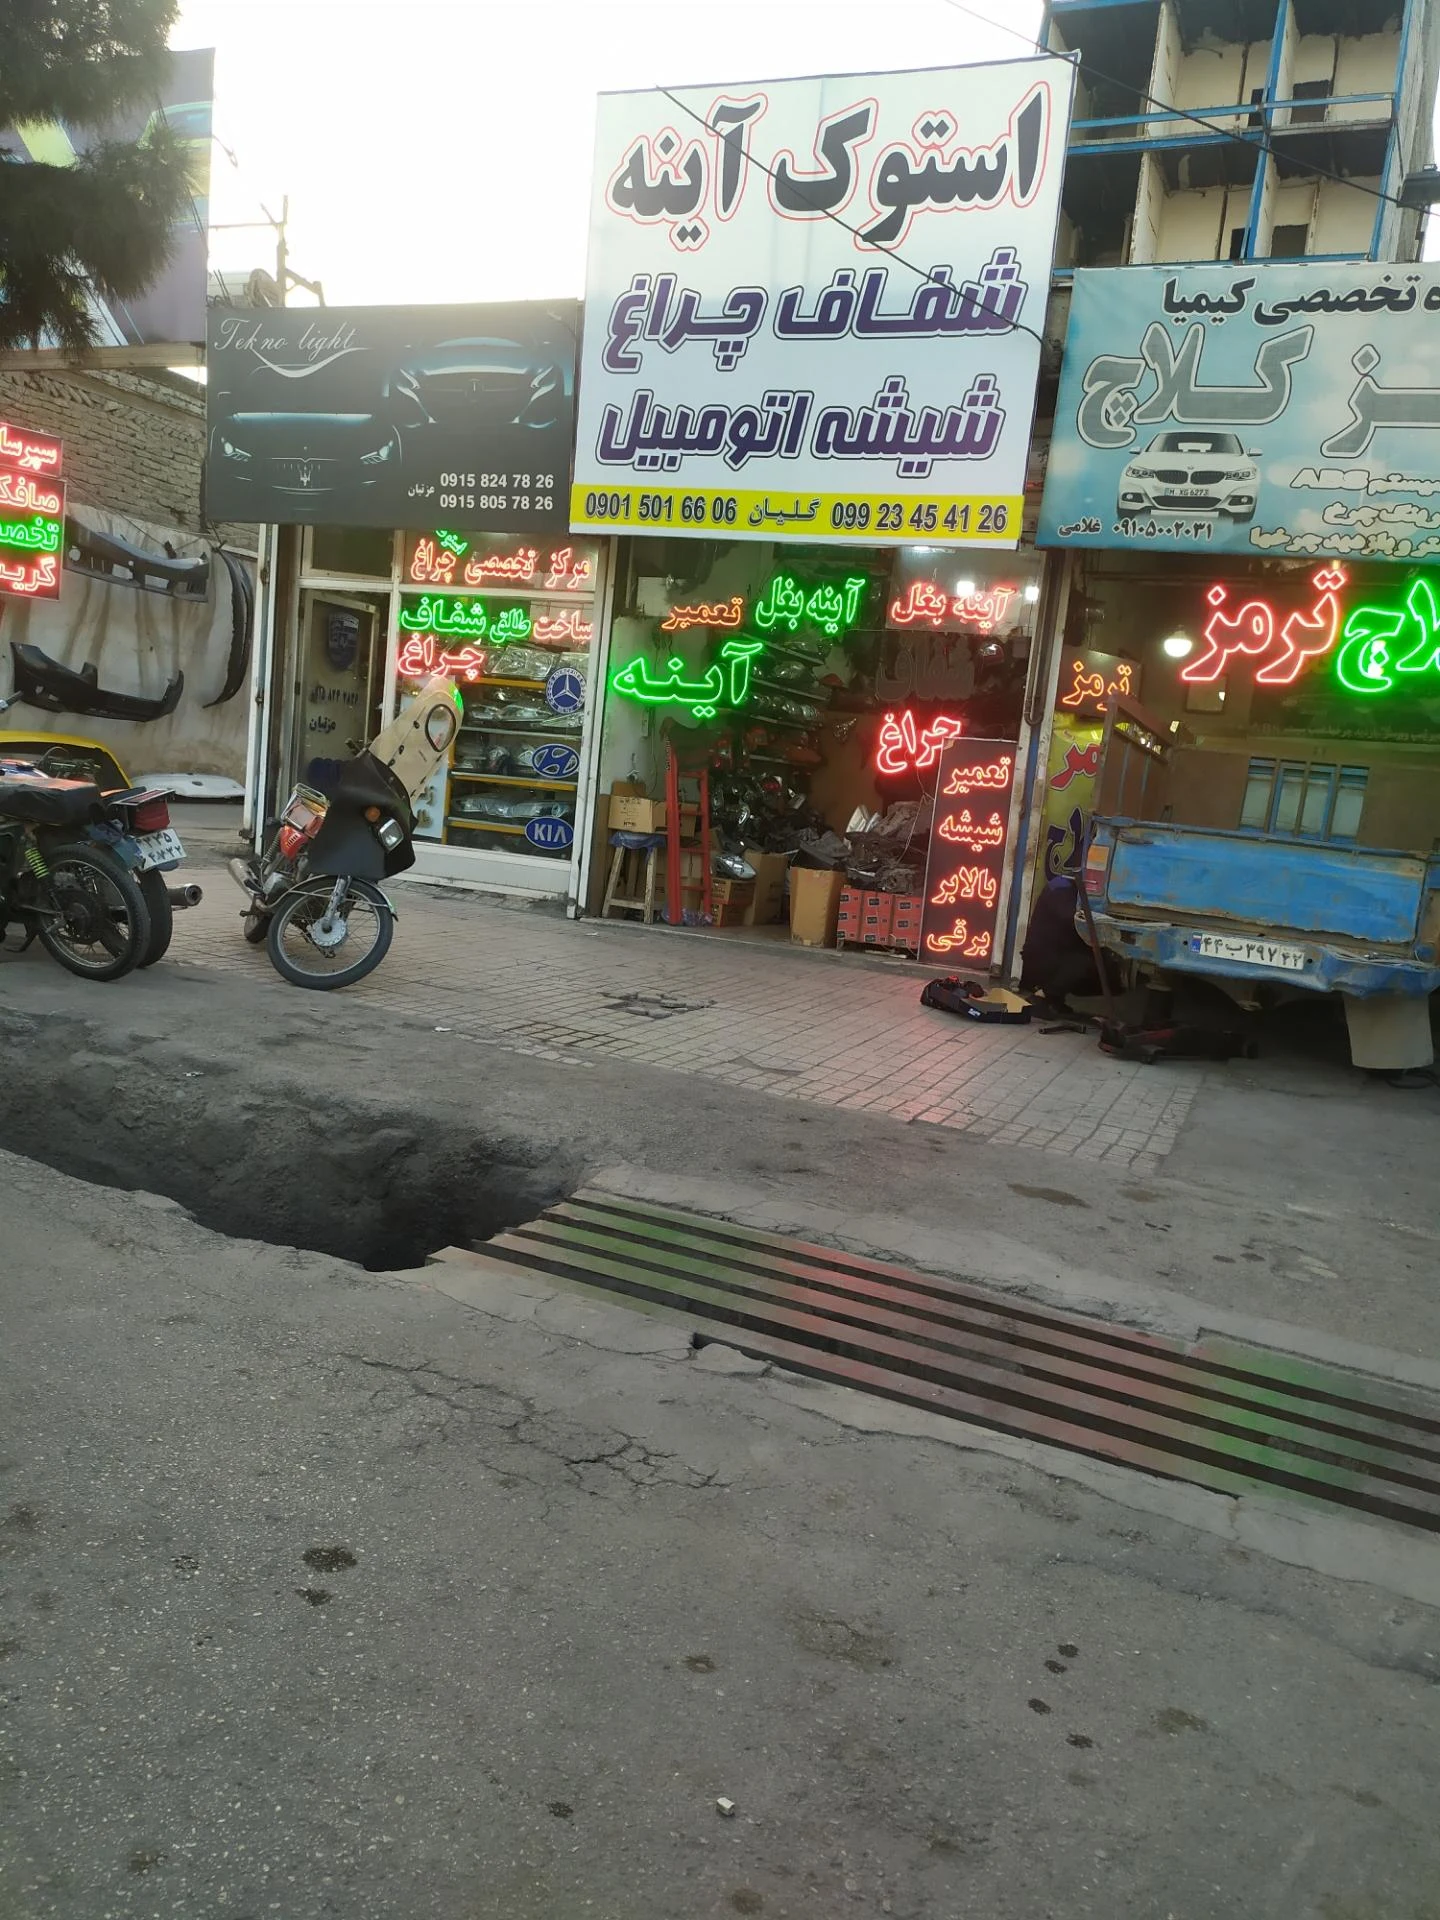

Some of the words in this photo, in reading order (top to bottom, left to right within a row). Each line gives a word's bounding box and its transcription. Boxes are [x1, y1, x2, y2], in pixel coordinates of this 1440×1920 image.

[608, 97, 765, 246] آینه
[769, 87, 1046, 246] استوک
[775, 249, 1026, 336] شفاف
[1164, 276, 1257, 325] کیمیا
[1253, 275, 1421, 326] تخصصی
[214, 318, 288, 351] Tekno
[298, 321, 358, 361] light
[603, 274, 767, 372] چراغ
[1077, 321, 1314, 449] کلاچ
[597, 390, 813, 470] اتومبیل
[811, 376, 1004, 477] شیشه
[439, 494, 475, 509] 0915
[479, 495, 507, 510] 805
[511, 495, 530, 510] 78
[534, 496, 554, 510] 26
[440, 472, 476, 488] 0915
[480, 473, 507, 489] 824
[512, 474, 531, 489] 78
[535, 474, 554, 489] 26
[585, 492, 631, 520] 0901
[637, 494, 673, 521] 501
[680, 494, 705, 522] 66
[711, 496, 737, 523] 06
[747, 496, 820, 526] گلیان
[831, 501, 871, 530] 099
[874, 503, 904, 530] 23
[909, 504, 937, 531] 45
[942, 504, 970, 532] 41
[977, 504, 1008, 533] 26
[410, 538, 457, 584] چراغ
[465, 547, 537, 585] تخصصی
[545, 547, 591, 589] مرکز
[400, 597, 487, 635] شفاف
[533, 610, 594, 640] ساخت
[661, 597, 743, 630] تعمیر
[755, 576, 804, 630] بغل
[806, 578, 866, 633] آینه
[891, 583, 947, 626] بغل
[953, 586, 1017, 629] آینه
[1181, 569, 1347, 683] ترمز
[398, 632, 485, 681] چراغ
[612, 641, 764, 718] آینه
[943, 757, 1012, 794] تعمیر
[532, 822, 568, 845] KIA
[938, 809, 1003, 853] شیشه
[931, 866, 997, 908] بالابر
[926, 918, 991, 957] برقی
